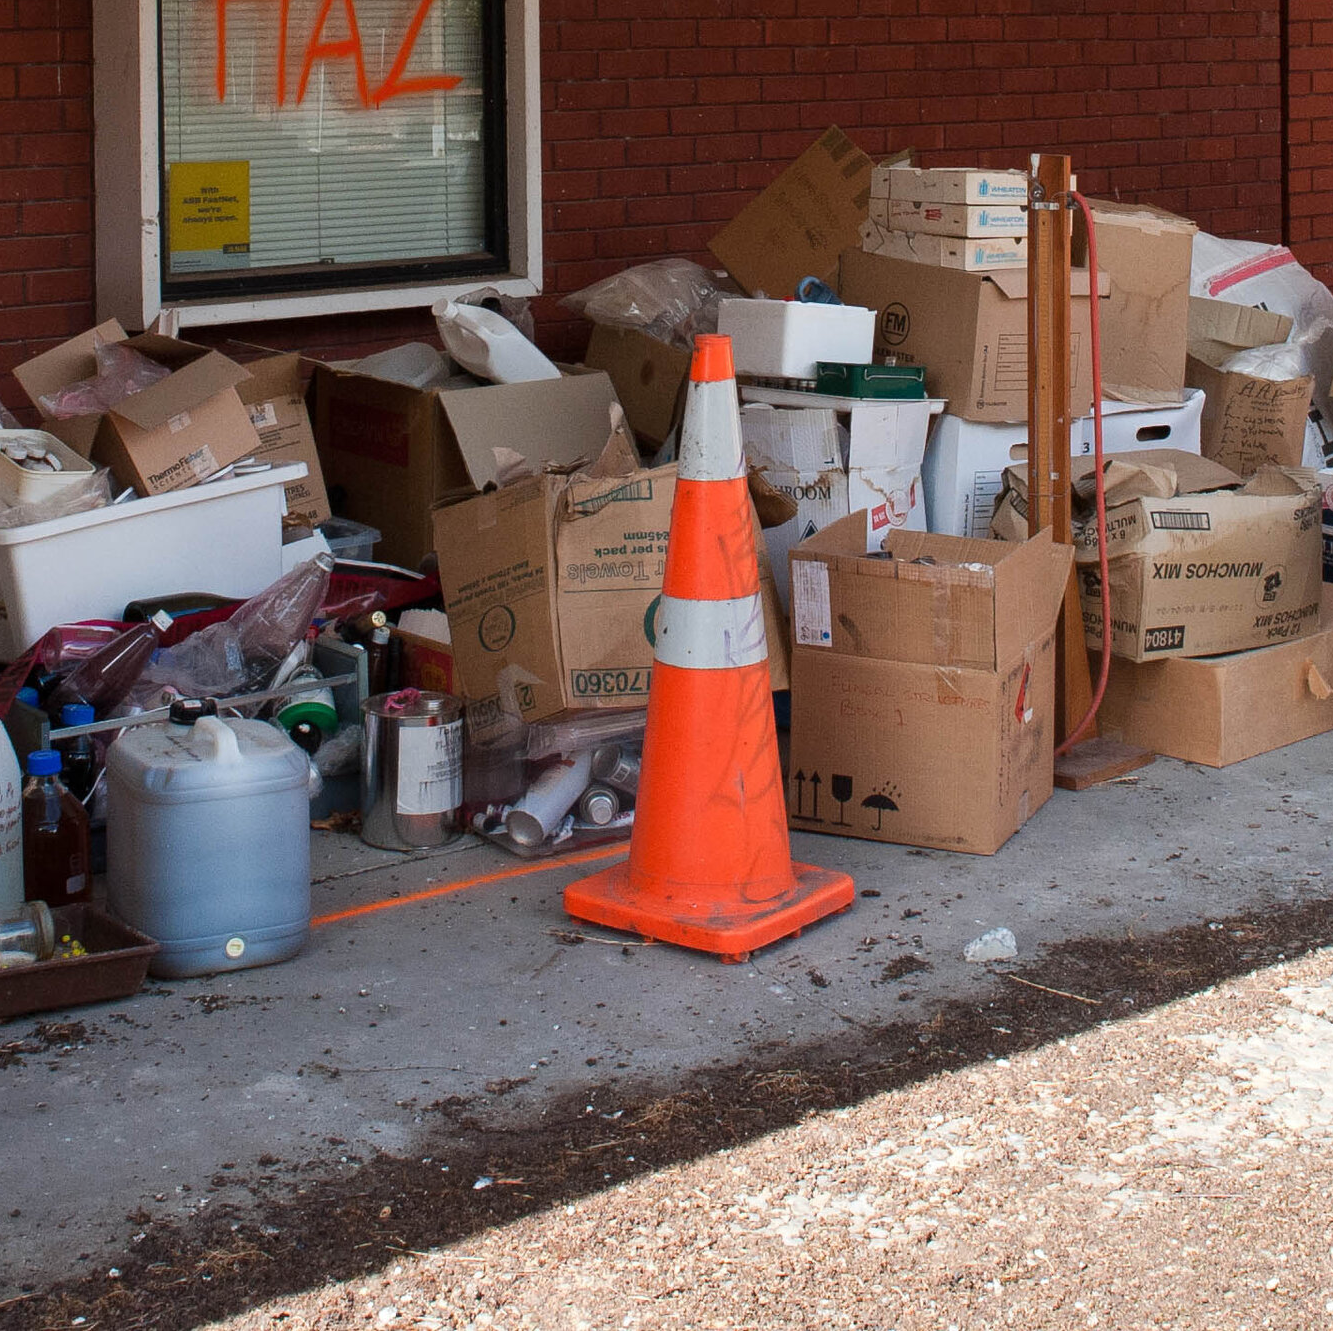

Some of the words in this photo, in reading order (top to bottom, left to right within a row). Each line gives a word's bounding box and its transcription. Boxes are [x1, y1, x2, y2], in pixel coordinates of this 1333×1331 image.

[886, 311, 906, 332] FM
[773, 483, 832, 501] HROOM
[593, 544, 628, 558] pack
[631, 545, 654, 557] per
[567, 560, 650, 585] Towels
[1153, 562, 1181, 580] MIX
[1185, 561, 1264, 579] MUNCHOS
[1145, 629, 1184, 648] 41804
